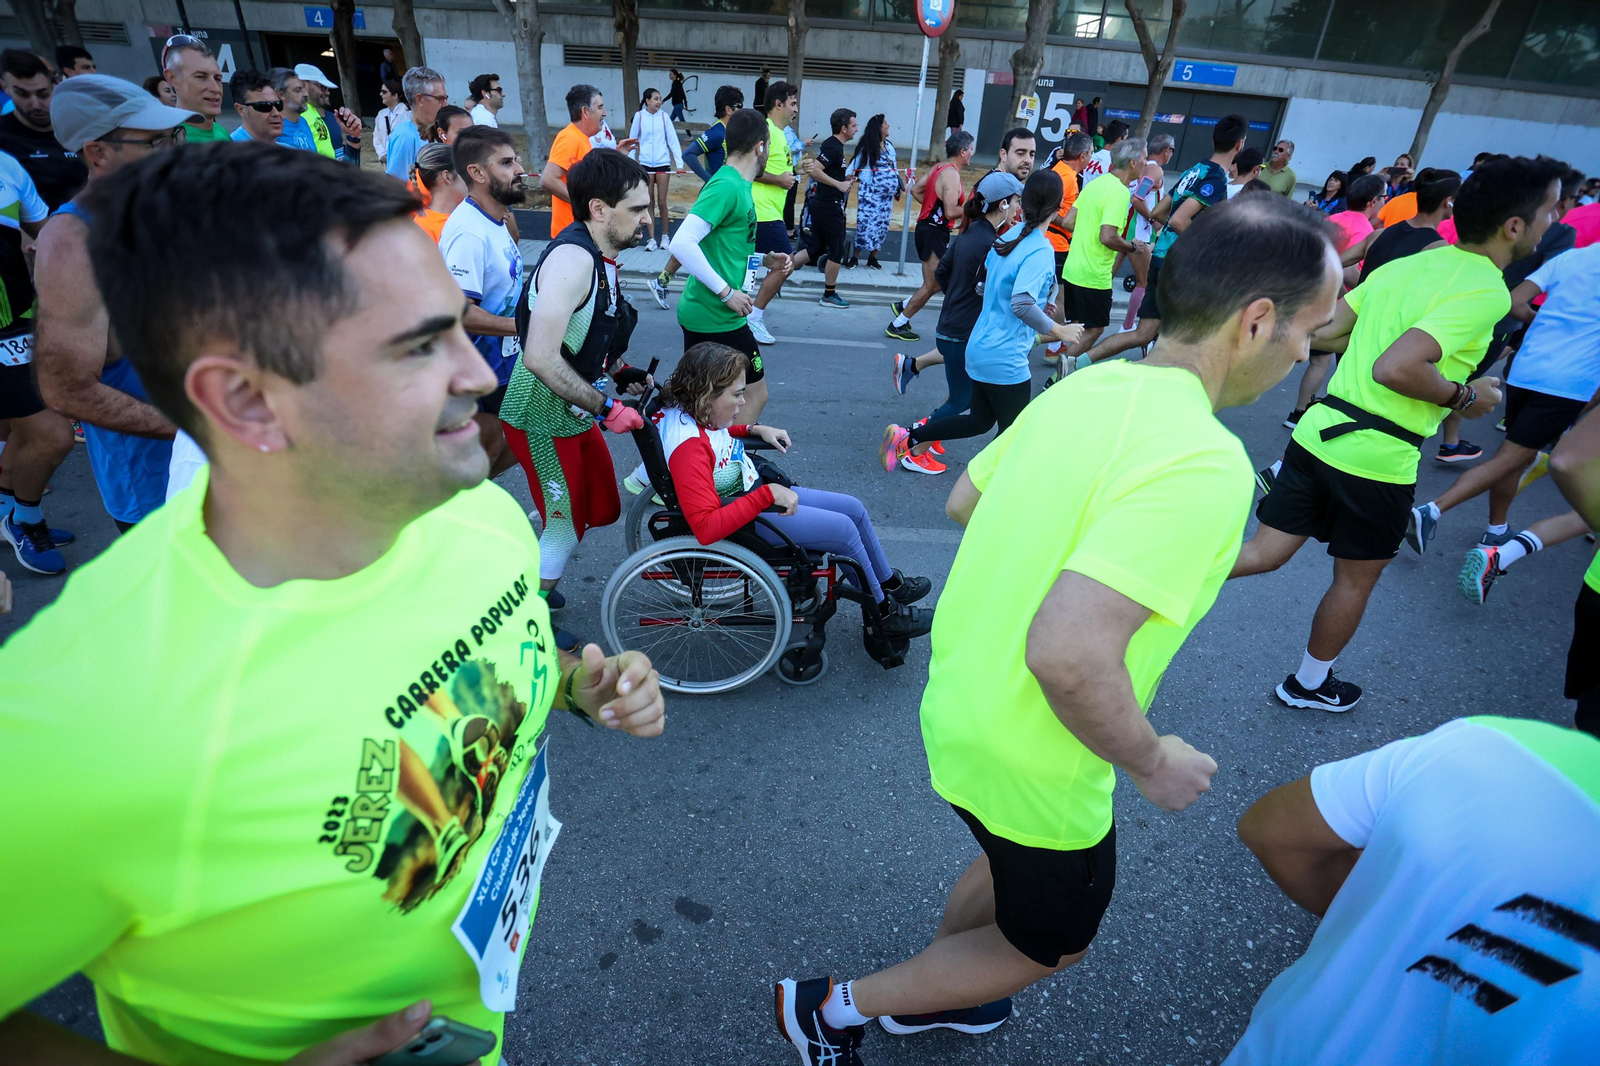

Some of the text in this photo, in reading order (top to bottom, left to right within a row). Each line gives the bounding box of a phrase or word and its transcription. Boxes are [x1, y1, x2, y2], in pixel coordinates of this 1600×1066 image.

[314, 10, 323, 26] 4
[1182, 64, 1194, 81] 5
[384, 638, 472, 729] CARRERA
[318, 796, 349, 844] 2023
[333, 738, 396, 873] JEREZ
[490, 845, 514, 901] Ciudad
[510, 827, 520, 846] de
[516, 789, 535, 827] Jerez
[476, 867, 494, 906] XLIII
[501, 818, 540, 943] 536
